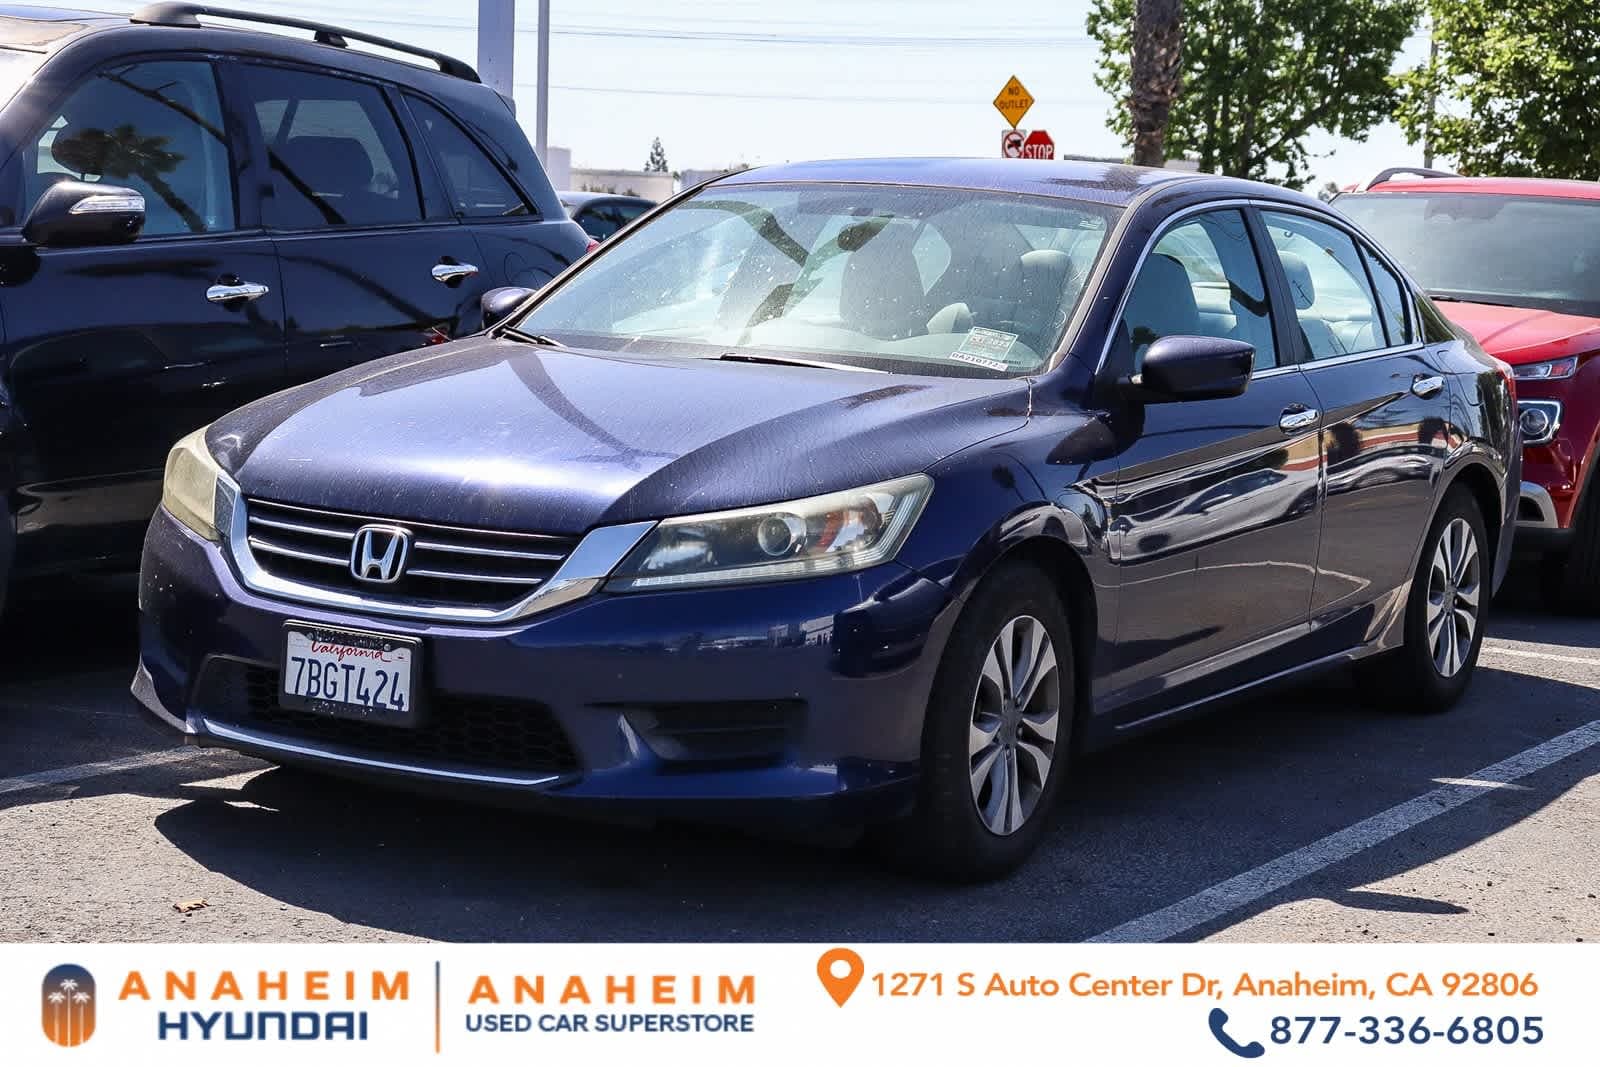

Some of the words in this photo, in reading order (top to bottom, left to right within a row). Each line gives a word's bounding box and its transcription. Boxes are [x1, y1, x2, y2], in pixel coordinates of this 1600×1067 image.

[1008, 86, 1020, 96] NO
[1000, 99, 1029, 109] OUTLET
[1025, 144, 1053, 159] STOP
[291, 656, 405, 711] 7BGT424
